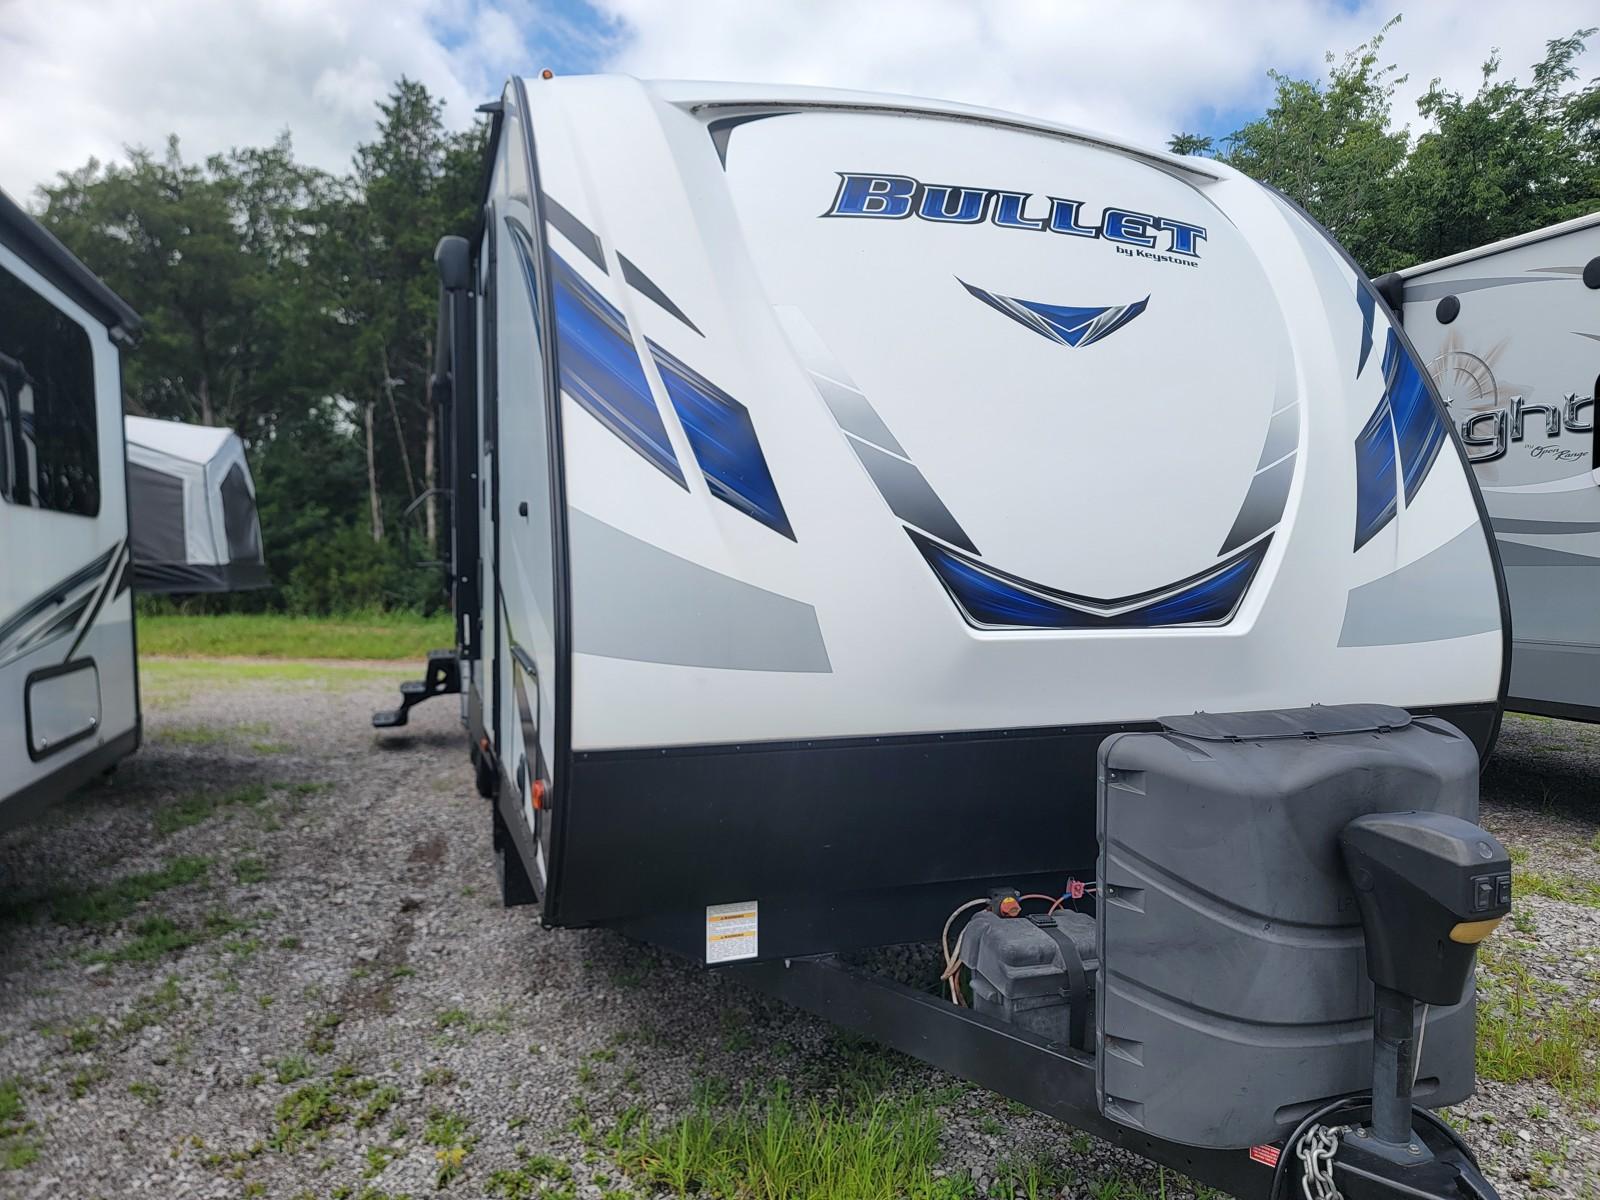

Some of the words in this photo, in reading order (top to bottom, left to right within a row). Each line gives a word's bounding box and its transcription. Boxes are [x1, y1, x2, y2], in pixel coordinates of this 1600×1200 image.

[816, 171, 1208, 259] BULLET
[1116, 245, 1134, 257] by
[1136, 248, 1199, 269] Keystone
[1530, 445, 1560, 460] Open
[1552, 449, 1590, 462] Range
